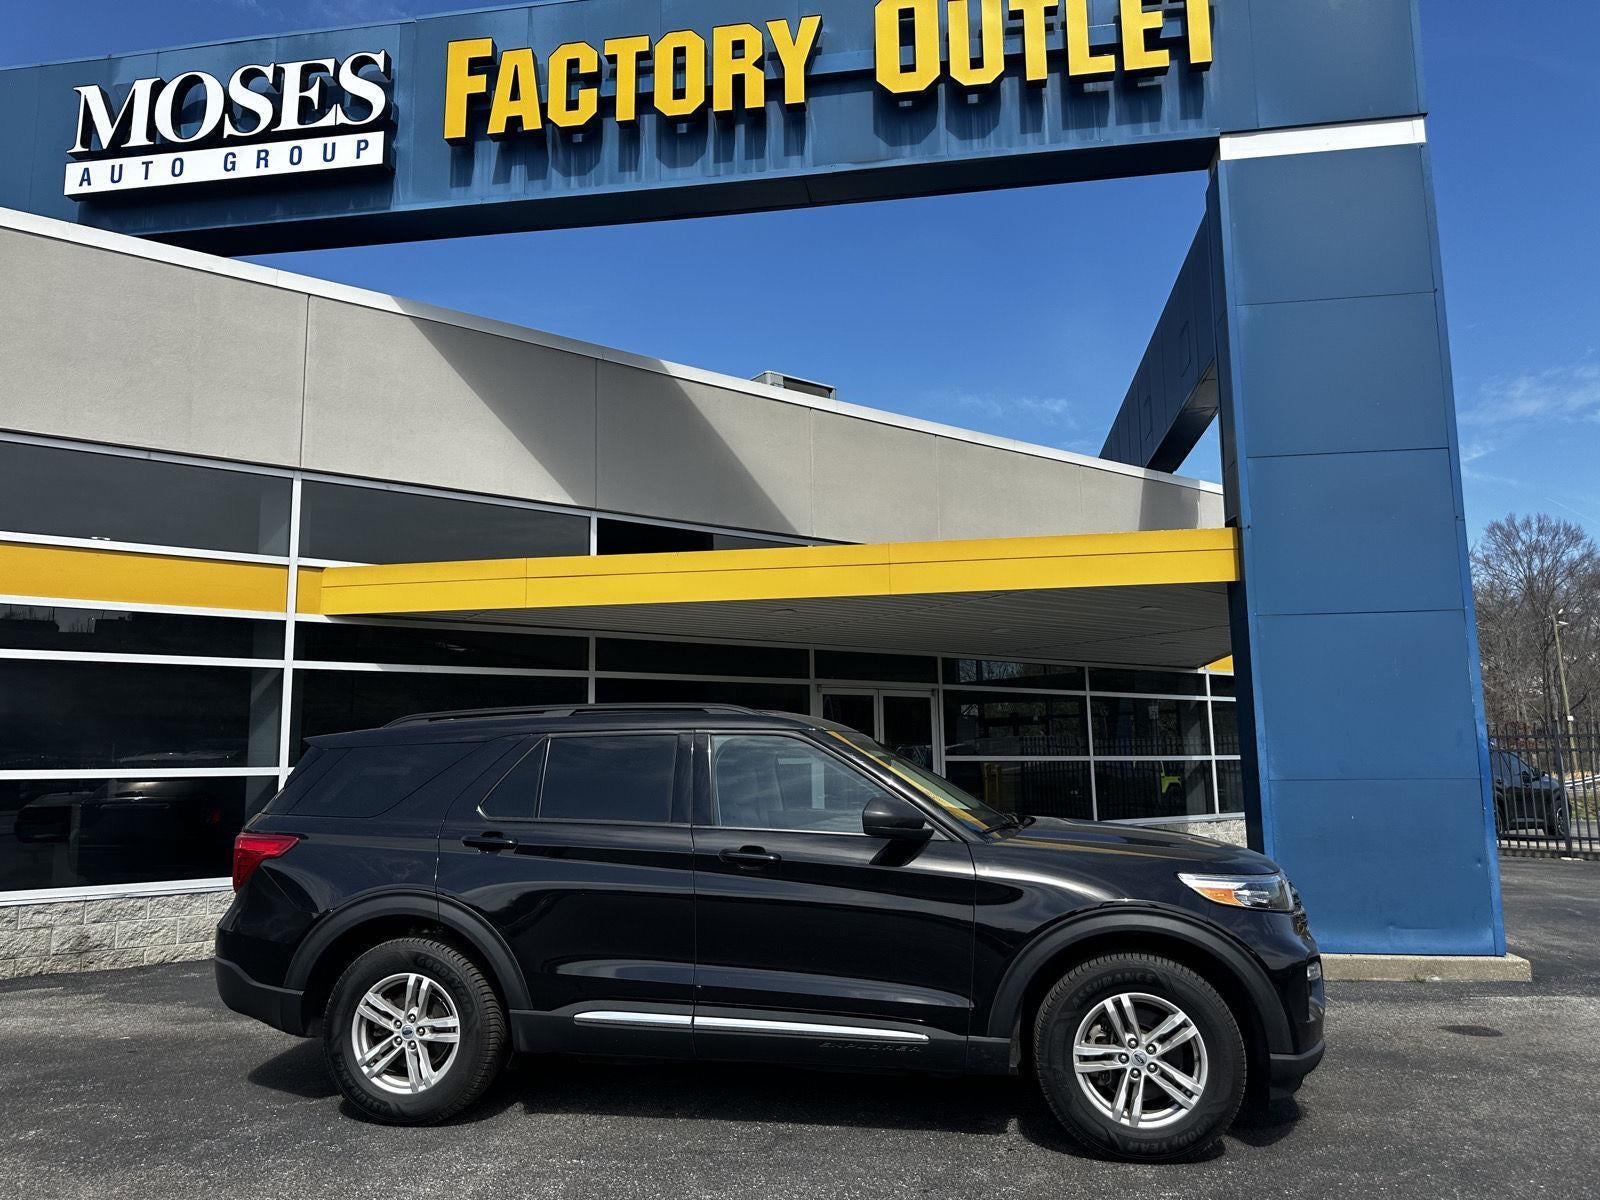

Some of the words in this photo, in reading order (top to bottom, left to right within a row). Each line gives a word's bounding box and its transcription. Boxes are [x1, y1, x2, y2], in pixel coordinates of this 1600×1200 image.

[66, 49, 390, 154] MOSES
[443, 15, 822, 140] FACTORY
[78, 157, 185, 188] AUTO
[222, 139, 370, 172] GROUP
